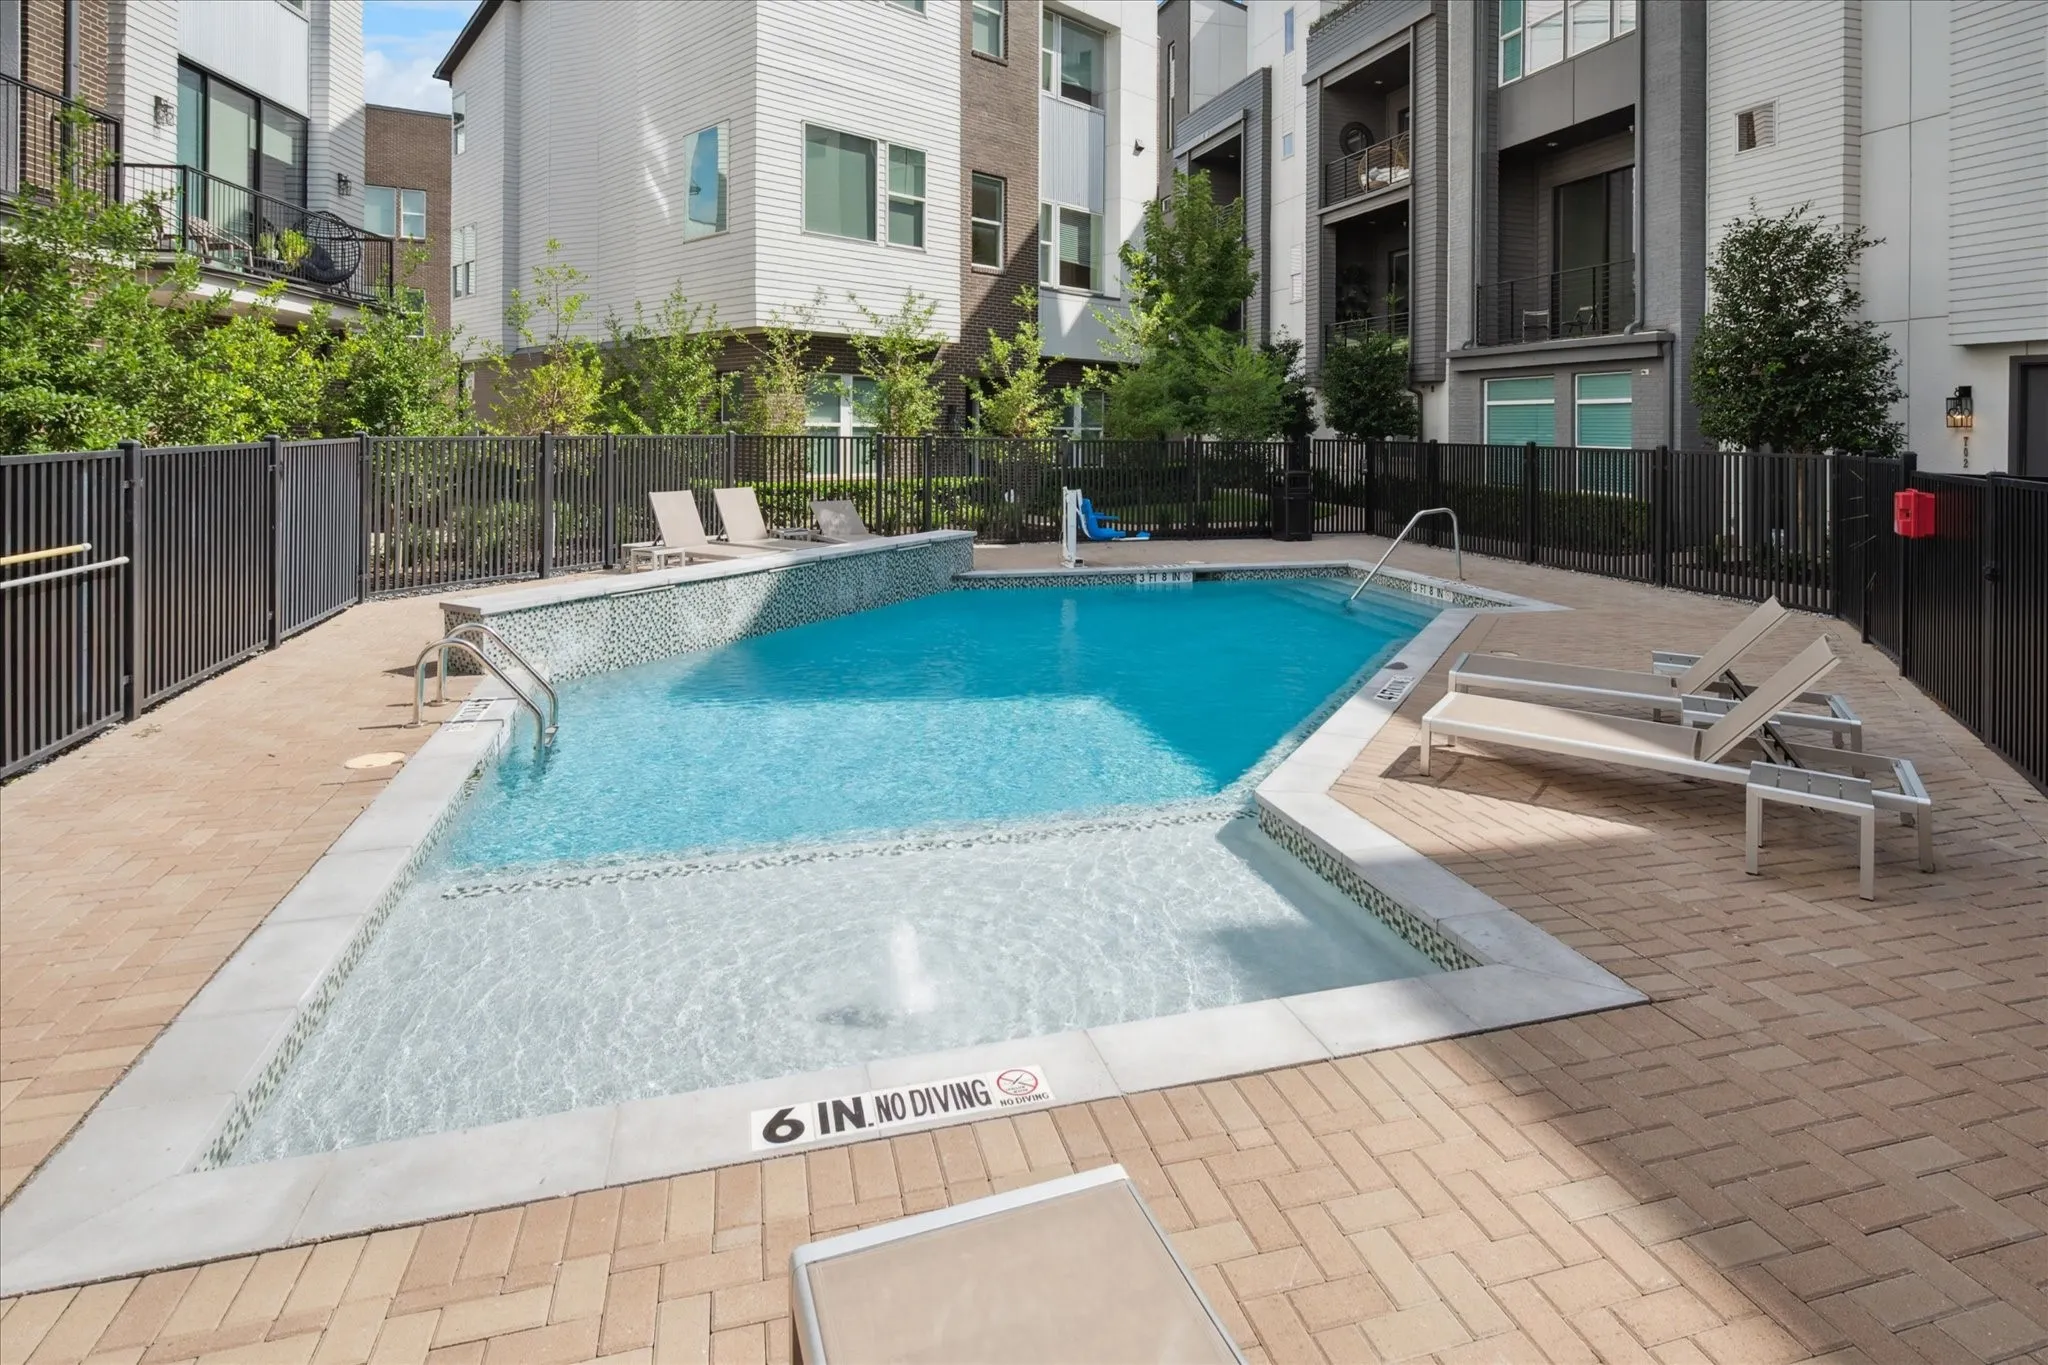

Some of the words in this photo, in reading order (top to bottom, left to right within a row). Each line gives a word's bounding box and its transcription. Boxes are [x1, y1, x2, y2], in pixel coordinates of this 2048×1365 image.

[1140, 573, 1145, 582] 3
[1149, 572, 1157, 582] FT
[1162, 572, 1167, 581] 8
[1172, 571, 1180, 581] IN
[1000, 1098, 1014, 1107] NO
[1015, 1092, 1049, 1104] DIVING
[762, 1107, 805, 1144] 6
[874, 1091, 907, 1124] NO
[912, 1079, 992, 1117] DIVING
